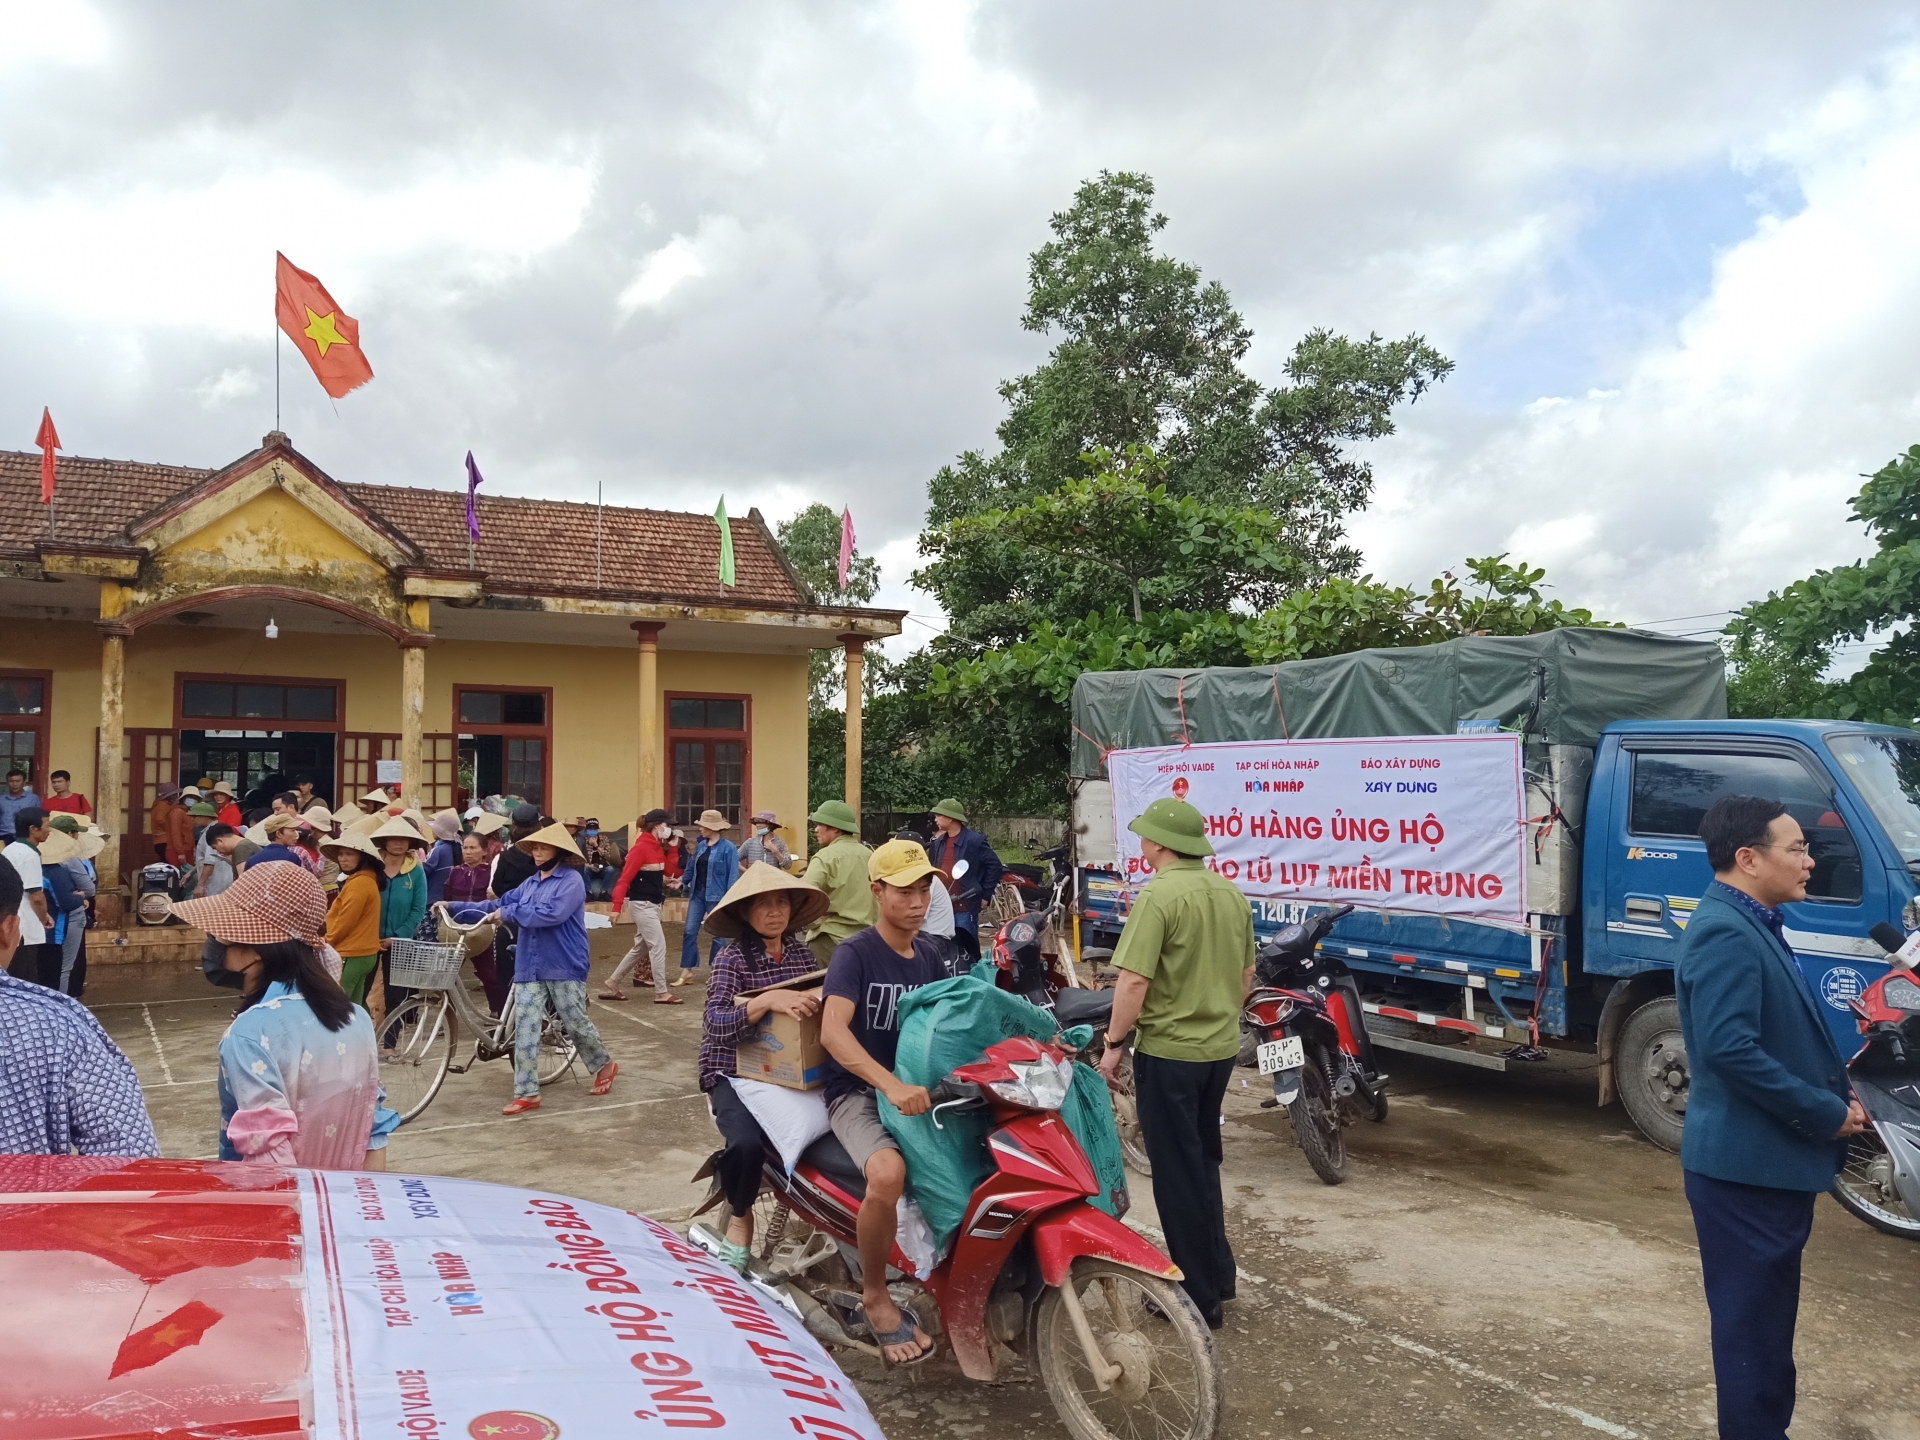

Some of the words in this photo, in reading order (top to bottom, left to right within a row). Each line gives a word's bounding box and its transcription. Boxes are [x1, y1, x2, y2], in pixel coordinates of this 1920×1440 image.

[1158, 763, 1174, 775] HIỆP
[1176, 761, 1190, 774] HỘI
[1192, 762, 1215, 772] VAIDE
[1235, 761, 1251, 773] TẠP
[1253, 758, 1270, 771] CHÍ
[1271, 758, 1292, 770] HÒA
[1294, 757, 1320, 772] NHẬP
[1360, 756, 1382, 769] BÁO
[1385, 756, 1406, 769] XÂY
[1409, 757, 1441, 771] DỰNG
[1273, 778, 1304, 794] NHẬP
[1396, 781, 1438, 794] DỰNG
[1250, 808, 1323, 840] HÀNG
[1331, 808, 1390, 842] ỦNG
[1400, 812, 1444, 852] HỘ
[1626, 847, 1678, 860] K3000S
[1208, 853, 1240, 880] ÀO
[1247, 856, 1272, 884] LŨ
[1280, 862, 1320, 892] LỤT
[1327, 854, 1392, 892] MIỀN
[1400, 869, 1503, 900] TRUNG
[1249, 901, 1309, 925] -120.87
[353, 1190, 381, 1204] XÂY
[356, 1205, 385, 1221] BÁO
[523, 1199, 593, 1231] BÀO
[988, 1210, 1013, 1219] HONDA
[363, 1238, 400, 1262] NHẬP
[368, 1263, 403, 1283] HÒA
[427, 1251, 472, 1281] NHẬP
[546, 1233, 642, 1295] ĐỒNG
[371, 1284, 407, 1304] CHÍ
[672, 1268, 790, 1342] MIỀN
[384, 1307, 419, 1328] TẠP
[584, 1301, 675, 1343] HỘ
[745, 1339, 847, 1413] LỤT
[395, 1369, 433, 1411] VAIDE
[630, 1351, 727, 1429] ỦNG
